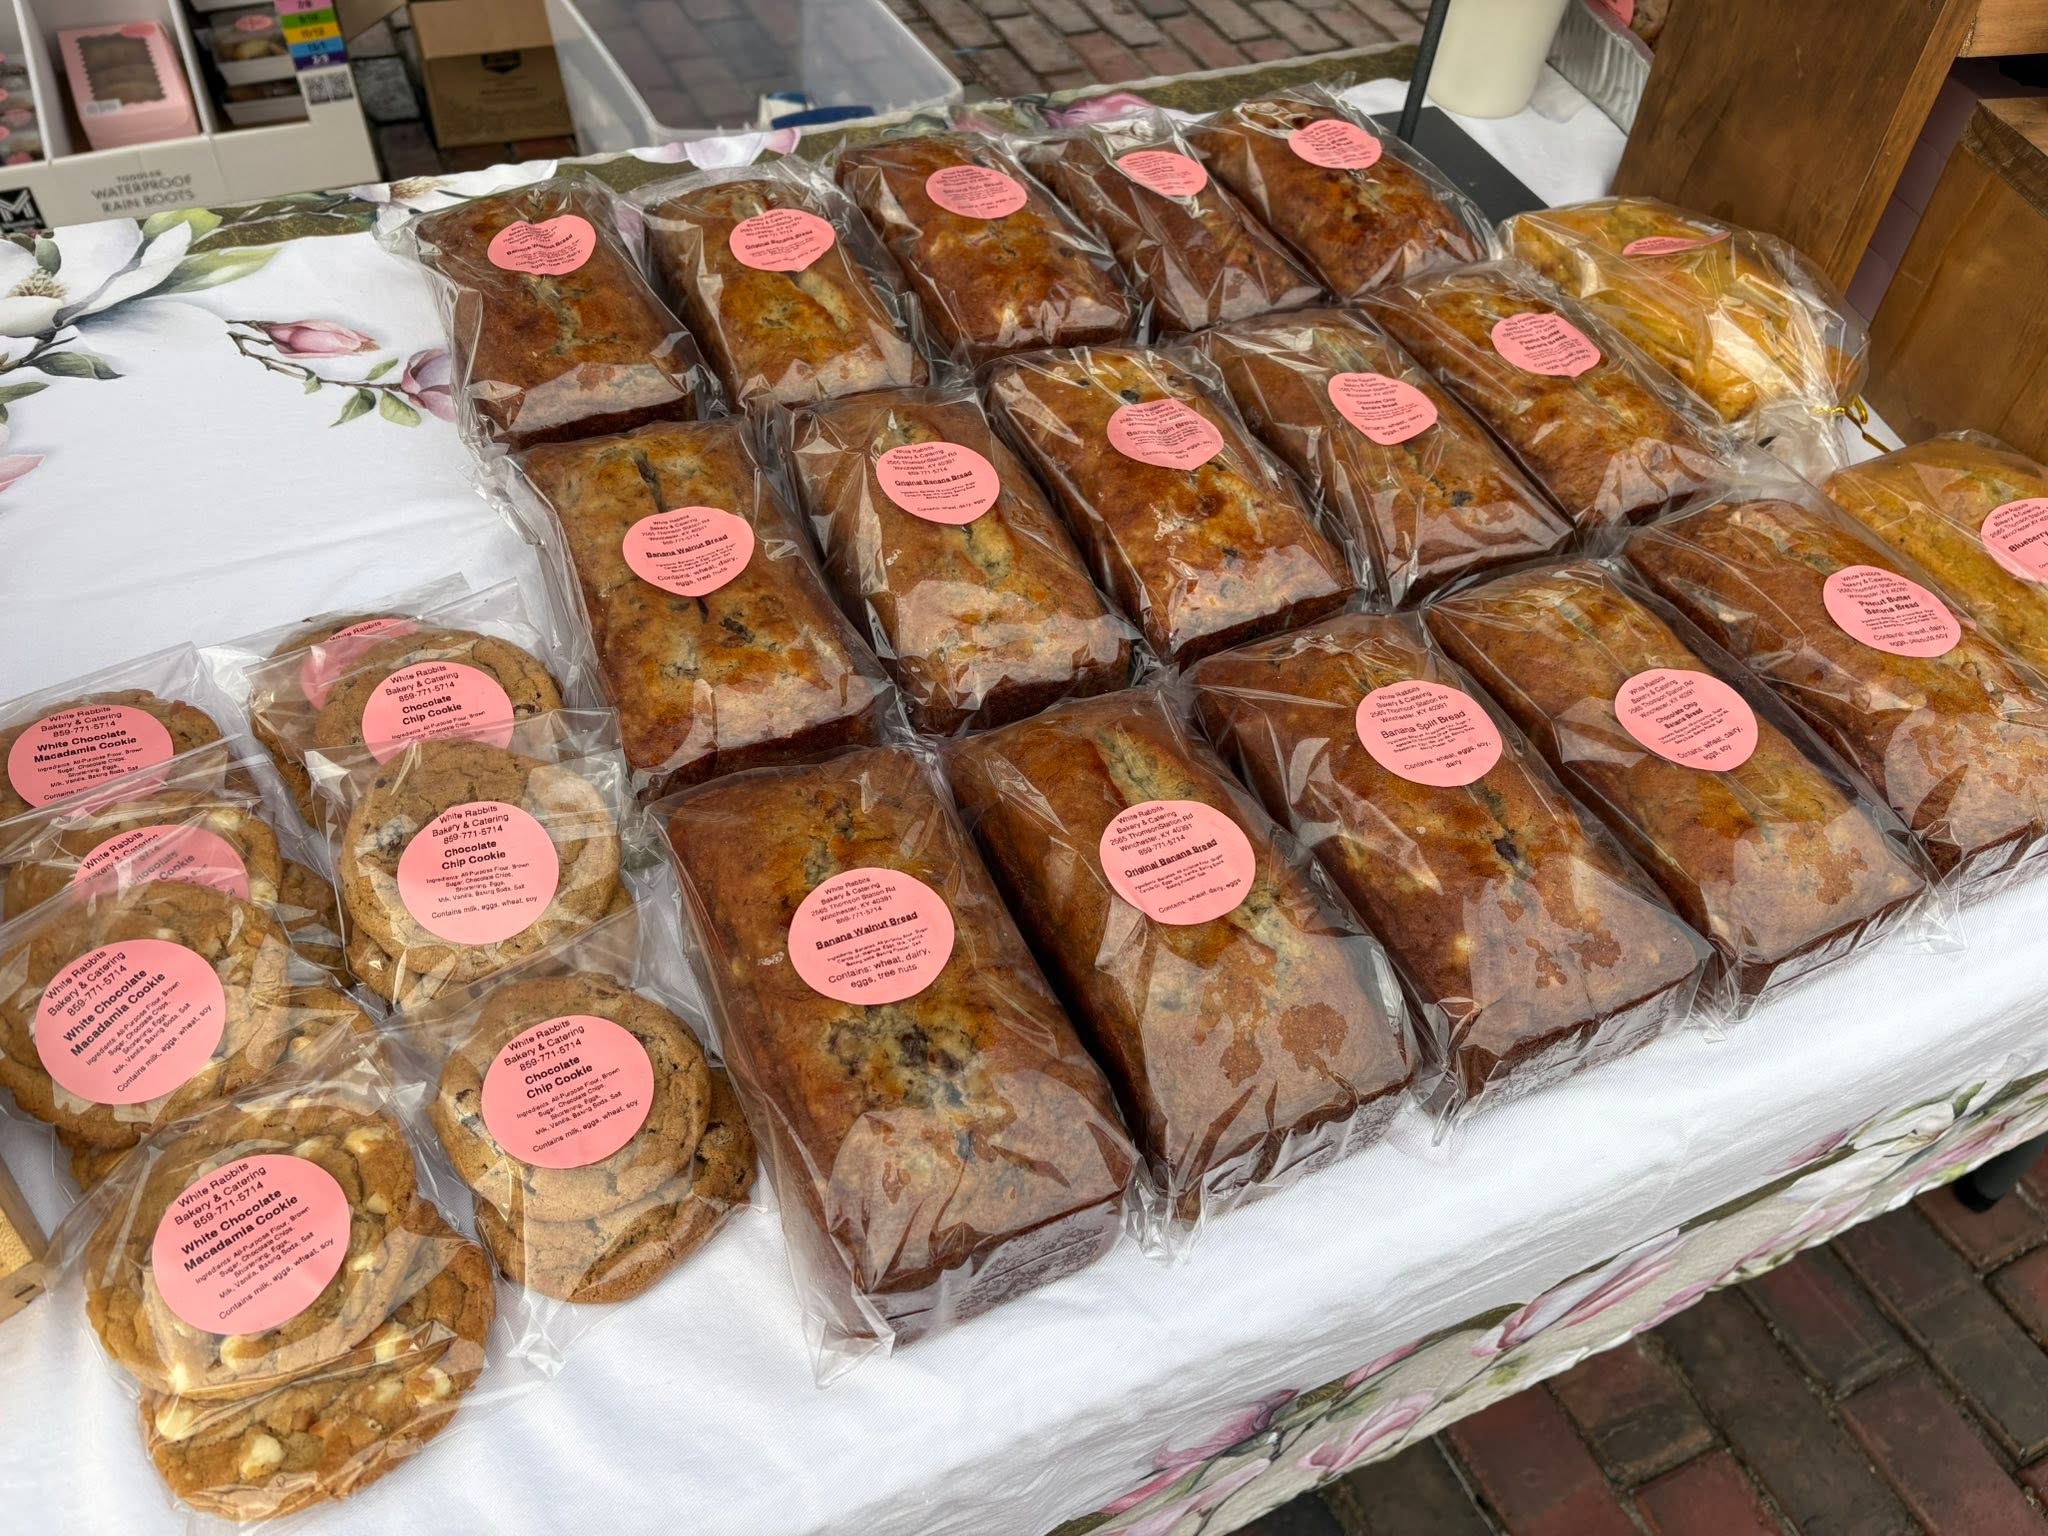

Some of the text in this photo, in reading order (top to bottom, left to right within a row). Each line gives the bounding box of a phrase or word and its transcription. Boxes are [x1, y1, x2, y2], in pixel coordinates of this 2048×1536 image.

[91, 174, 192, 200] WATERPROOF
[101, 188, 195, 213] RAIN BOOTS
[894, 470, 973, 487] Original Banana Bread
[645, 533, 728, 558] Banana Walnut Bread
[1857, 594, 1911, 607] Peanut Butter
[1863, 601, 1920, 615] Banana Bread
[385, 672, 459, 696] Bakery & Catering
[389, 665, 447, 684] White Rabbits
[398, 680, 455, 702] 859-771-5714
[48, 706, 111, 722] White Rabbits
[401, 695, 452, 714] Chocolate
[402, 703, 462, 725] Chip Cookie
[1655, 701, 1698, 724] Chocolate Chip
[40, 721, 72, 732] Bakery
[83, 712, 122, 724] Catering
[52, 719, 116, 738] 859-771-5714
[1380, 709, 1466, 739] Banana Split Bread
[1663, 707, 1704, 729] Banana Bread
[33, 737, 137, 763] Macadamia Cookie
[36, 729, 126, 752] White Chocolate
[432, 814, 509, 837] Bakery & Catering
[438, 805, 498, 824] White Rabbits
[1115, 822, 1141, 834] Bakery
[1147, 811, 1178, 824] Catering
[1116, 805, 1165, 824] White Rabbits
[1181, 812, 1194, 822] Rd
[443, 824, 503, 845] 859-771-5714
[1137, 834, 1186, 856] 859-771-5714
[1159, 829, 1170, 838] KY
[82, 851, 110, 870] White
[108, 832, 144, 853] Rabbits
[441, 850, 506, 870] Chip Cookie
[444, 840, 497, 858] Chocolate
[1124, 838, 1218, 878] Original Banana Bread
[158, 854, 195, 880] Cookie
[820, 893, 844, 906] Bakery
[851, 882, 881, 895] Catering
[823, 877, 871, 895] White Rabbits
[1225, 878, 1241, 888] eggs
[431, 908, 462, 919] Contains
[463, 904, 480, 913] milk,
[501, 897, 524, 906] wheat,
[525, 895, 538, 903] soy
[815, 911, 918, 950] Banana Walnut Bread
[45, 950, 107, 999] White Rabbits
[827, 947, 931, 984] Contains: wheat, dairy,
[850, 963, 918, 988] eggs, tree nuts
[47, 951, 126, 1016] Bakery & Catering
[66, 964, 127, 1017] 859-771-5714
[62, 970, 147, 1041] White Chocolate
[70, 973, 165, 1057] Macadamia Cookie
[503, 1025, 585, 1066] Bakery & Catering
[507, 1019, 570, 1051] White Rabbits
[116, 1004, 212, 1092] Contains milk, eggs, wheat, soy
[519, 1038, 582, 1071] 859-771-5714
[524, 1056, 580, 1085] Chocolate
[526, 1065, 593, 1099] Chip Cookie
[532, 1135, 564, 1152] Contains
[564, 1127, 582, 1138] milk,
[601, 1105, 625, 1120] wheat,
[625, 1099, 638, 1109] soy
[173, 1166, 267, 1226] Bakery & Catering
[177, 1162, 249, 1208] White Rabbits
[192, 1180, 264, 1229] 859-771-5714
[180, 1190, 282, 1255] White Chocolate
[183, 1196, 298, 1272] Macadamia Cookie
[218, 1237, 334, 1320] Contains milk, eggs, wheat, soy
